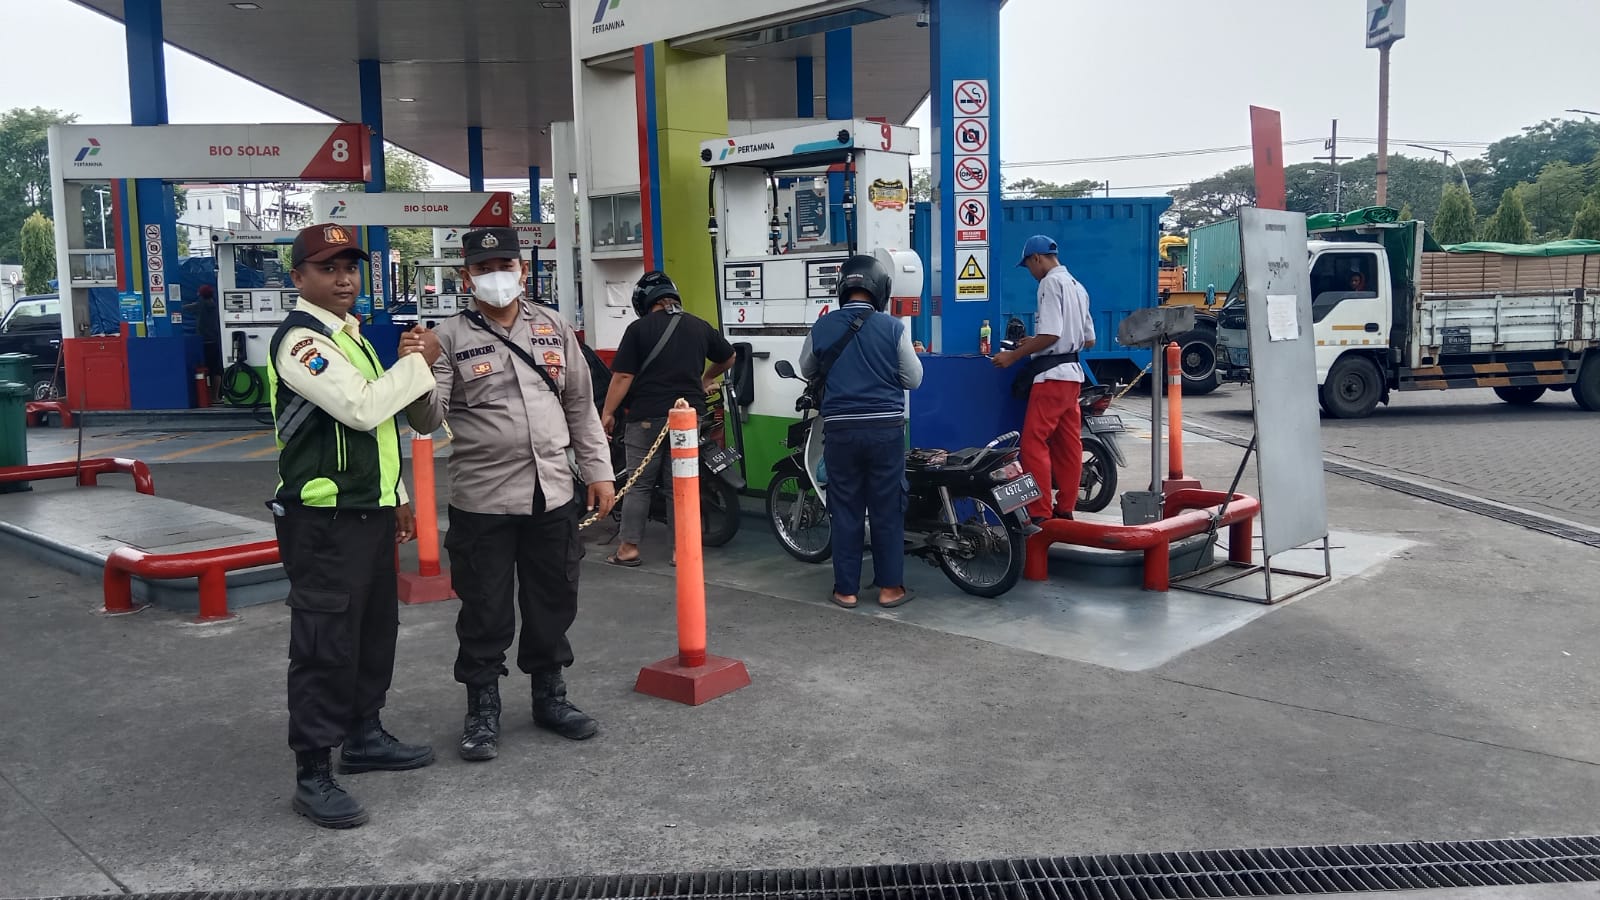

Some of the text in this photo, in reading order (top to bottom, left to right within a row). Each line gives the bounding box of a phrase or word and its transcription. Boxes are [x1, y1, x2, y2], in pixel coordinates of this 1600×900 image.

[592, 20, 624, 34] PERTAMINA
[881, 125, 891, 151] 9
[209, 146, 280, 156] BIO SOLAR
[332, 139, 349, 162] 8
[738, 142, 775, 154] PERTAMINA
[491, 202, 503, 216] 6
[737, 308, 745, 323] 3
[292, 339, 313, 355] POLDA
[531, 338, 562, 346] POLRI
[1005, 483, 1022, 496] 4972
